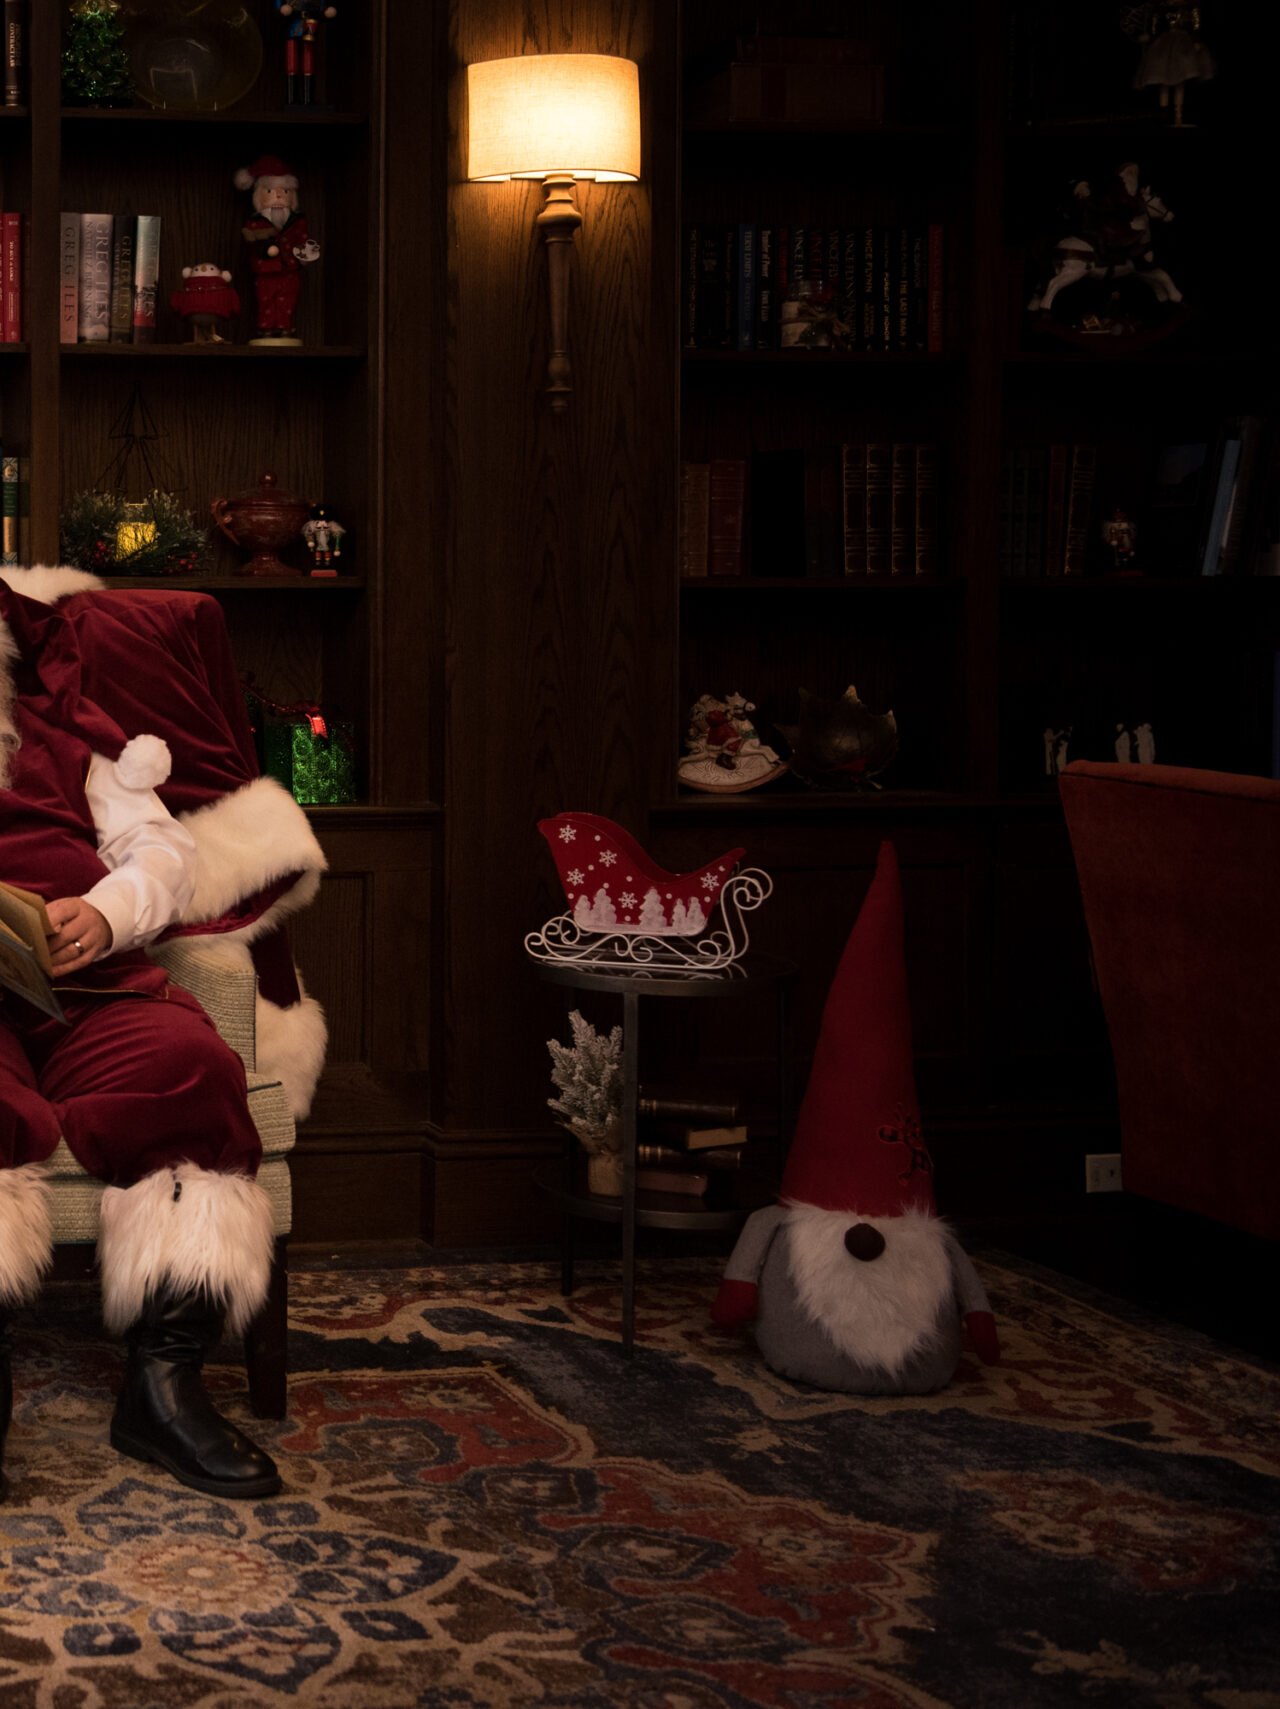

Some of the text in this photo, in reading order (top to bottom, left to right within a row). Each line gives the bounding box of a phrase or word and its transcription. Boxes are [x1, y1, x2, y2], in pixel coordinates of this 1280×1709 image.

[793, 229, 805, 260] VINCE
[827, 230, 840, 263] VINCE
[845, 232, 856, 262] VINCE
[864, 229, 873, 293] VINCE FLYNN
[64, 227, 76, 322] GREG ILES
[81, 222, 93, 320] NATCHEZ BURNING
[95, 222, 109, 320] GREG ILES
[119, 235, 133, 320] GREG ILES
[845, 264, 856, 297] FLYNN
[883, 271, 891, 302] PURSUIT
[883, 304, 891, 313] OF
[899, 280, 909, 337] THE LAST MAN
[883, 315, 891, 341] HONOR
